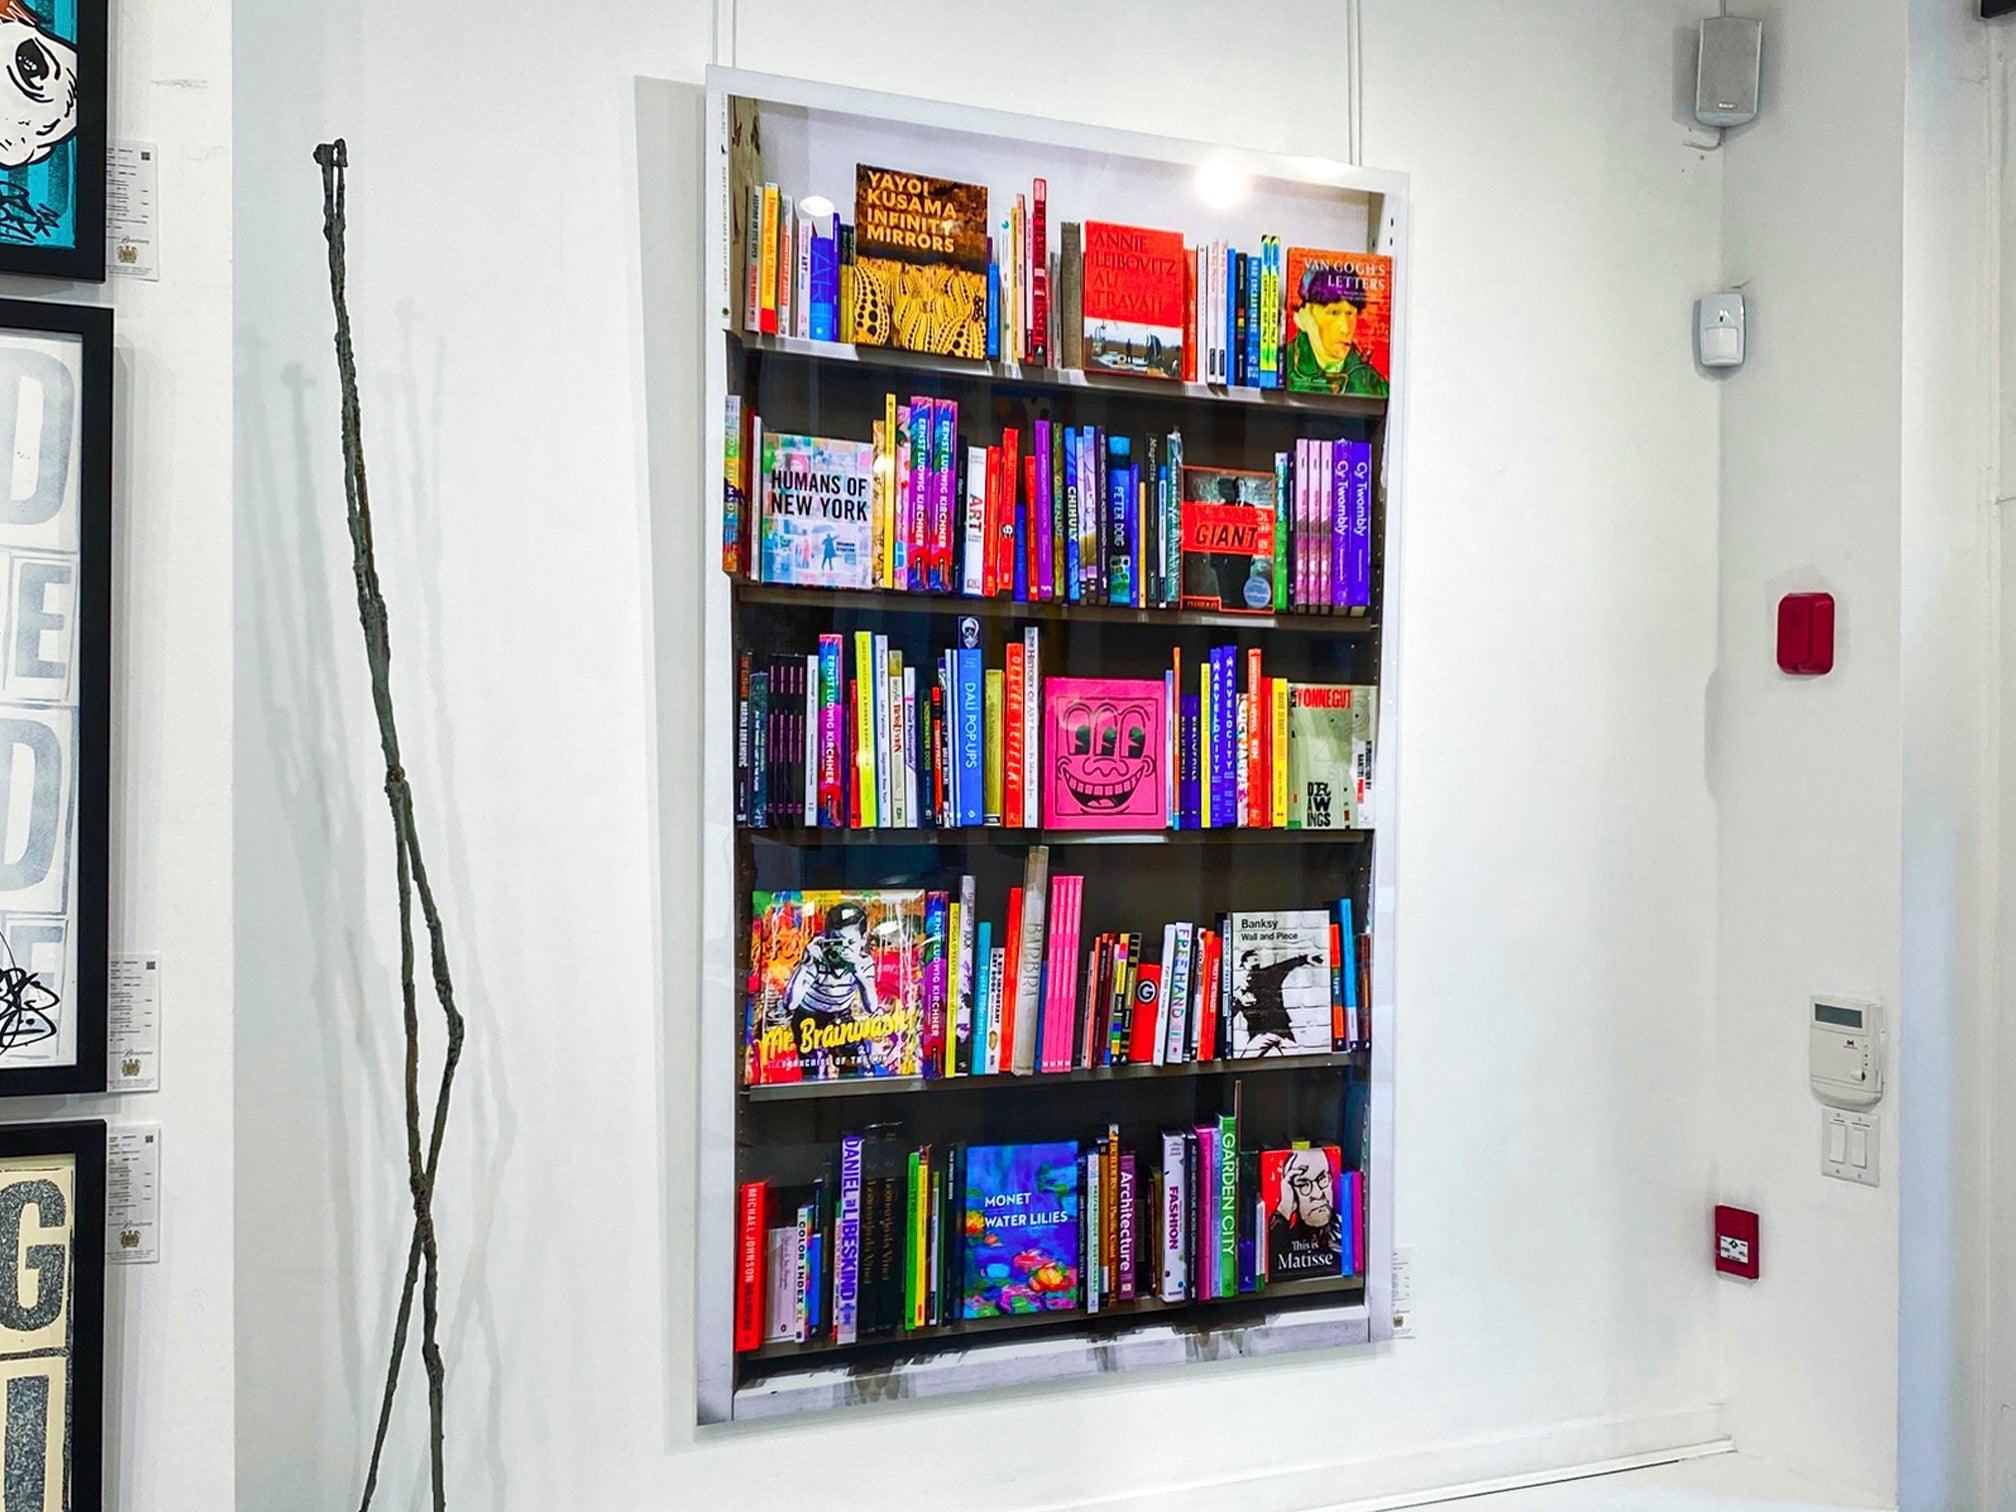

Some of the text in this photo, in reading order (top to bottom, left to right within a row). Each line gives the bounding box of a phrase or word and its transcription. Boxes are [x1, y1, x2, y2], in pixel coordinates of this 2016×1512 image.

[867, 170, 929, 197] YAYOI
[867, 188, 957, 219] KUSAMA
[867, 207, 954, 236] INFINITY
[867, 224, 955, 252] MIRRORS
[1092, 231, 1148, 253] ANNIE
[1092, 250, 1177, 275] LEIBOVITZ
[1093, 270, 1119, 288] AU
[1303, 257, 1330, 272] VAN
[1327, 274, 1386, 291] LETTERS
[1096, 289, 1163, 314] TRAVAIL
[1148, 437, 1157, 482] Magritte
[771, 470, 868, 497] HUMANS OF
[915, 418, 926, 547] ERNST LUDWIG KIRCHNER
[938, 420, 950, 549] ERNST LUDWIG KIRCHNER
[1335, 460, 1348, 536] Cy Twombly
[1353, 462, 1368, 536] Cy Twombly
[771, 497, 868, 521] NEW YORK
[969, 494, 982, 532] ART
[1067, 486, 1077, 543] CHIHULY
[1113, 486, 1124, 546] PETER DOIG
[1195, 522, 1258, 549] GIANT
[14, 561, 72, 680] E
[1010, 656, 1020, 711] OLIVER
[826, 655, 835, 784] ERNST LUDWIG KIRCHNER
[966, 682, 978, 768] DALÍ POP-UPS
[1226, 656, 1234, 770] MARVELOCITY
[1307, 812, 1331, 828] INGS
[1240, 918, 1278, 930] Banksy
[1240, 932, 1298, 942] Wall and Piece
[931, 911, 942, 1036] ERNST LUDWIG KIRCHNER
[1022, 922, 1043, 998] BARBRA
[1172, 929, 1190, 1018] FREEHAND
[994, 976, 1002, 1023] IMPORTANT
[800, 1003, 914, 1054] Brainwash
[746, 1188, 757, 1231] MICHAEL
[984, 1192, 1032, 1208] MONET
[1222, 1132, 1235, 1256] GARDEN CITY
[841, 1138, 860, 1300] DANIEL LIBESKIND
[864, 1180, 876, 1284] Leonardo da Vinci
[880, 1177, 895, 1282] Leonardo da Vinci
[984, 1210, 1069, 1229] WATER LILIES
[1110, 1206, 1118, 1232] Pacific
[1120, 1171, 1133, 1270] Architecture
[1169, 1186, 1179, 1250] FASHION
[0, 1178, 67, 1331] G
[744, 1234, 756, 1283] JOHNSON
[798, 1221, 806, 1260] COLOR
[1110, 1234, 1118, 1258] Coast
[1278, 1250, 1334, 1270] Matisse
[1291, 1239, 1310, 1251] This
[796, 1264, 805, 1304] INDEX
